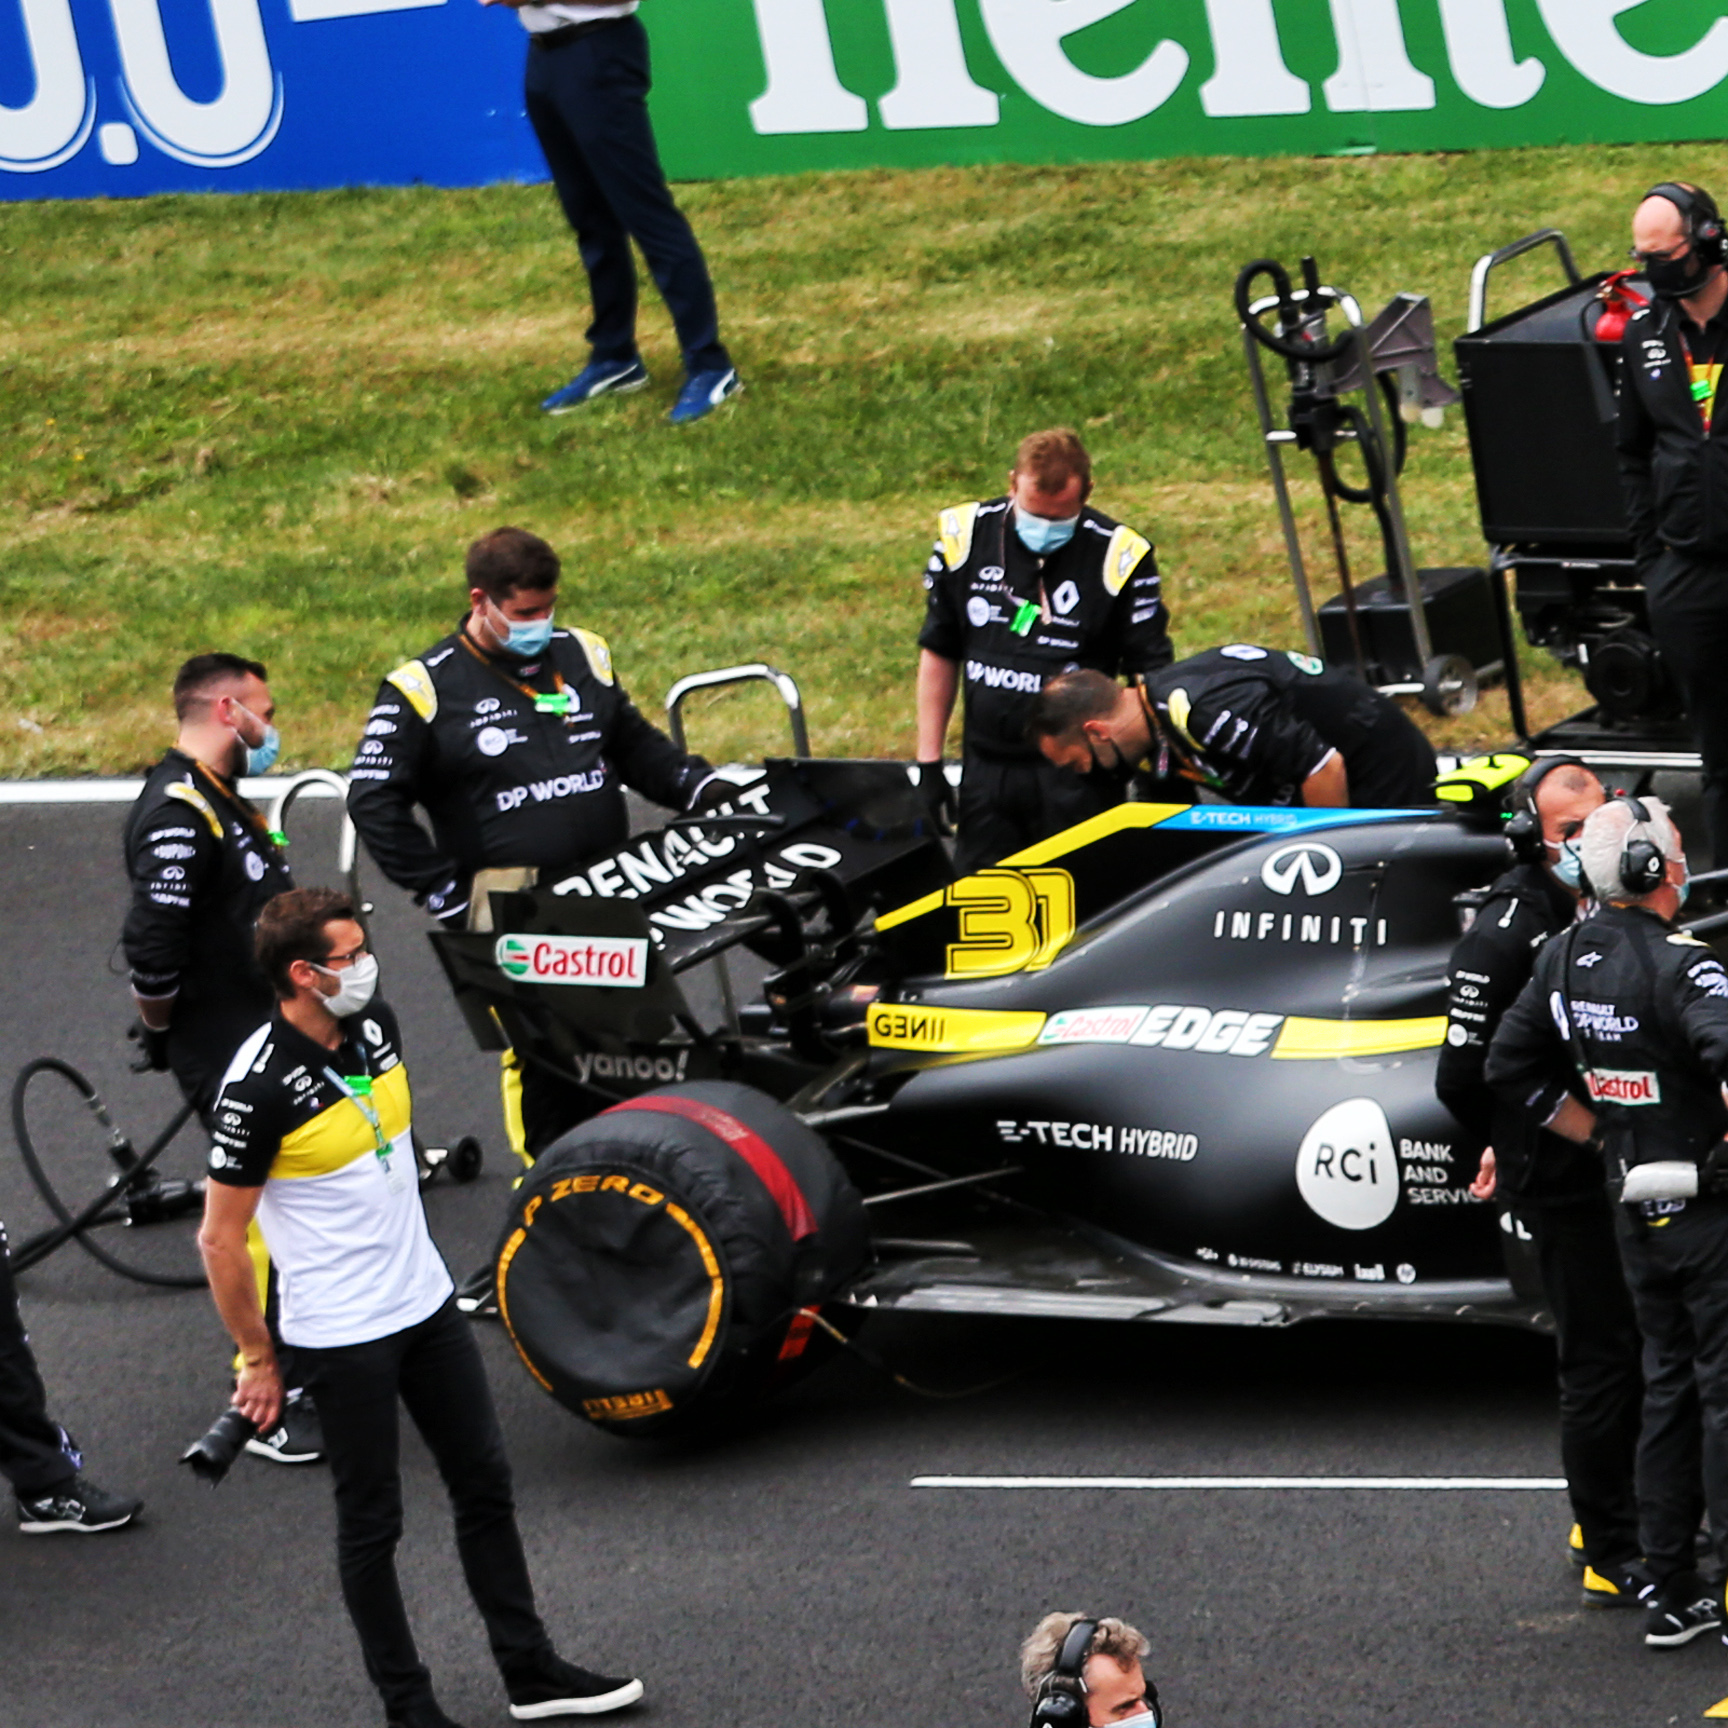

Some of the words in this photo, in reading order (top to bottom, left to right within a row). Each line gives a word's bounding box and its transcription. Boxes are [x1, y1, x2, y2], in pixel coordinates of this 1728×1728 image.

[532, 770, 604, 801] WORLD
[1189, 810, 1251, 826] E-TECH
[945, 868, 1076, 981] 31
[1213, 909, 1389, 947] INFINITI
[533, 942, 638, 981] Castrol
[1061, 1013, 1135, 1042] Castrol
[1130, 1005, 1287, 1057] EDGE
[997, 1119, 1115, 1152] E-TECH
[1120, 1127, 1199, 1163] HYBRID
[1399, 1138, 1455, 1163] BANK
[1404, 1164, 1449, 1186] AND
[523, 1195, 543, 1228] P
[550, 1174, 665, 1206] ZERO
